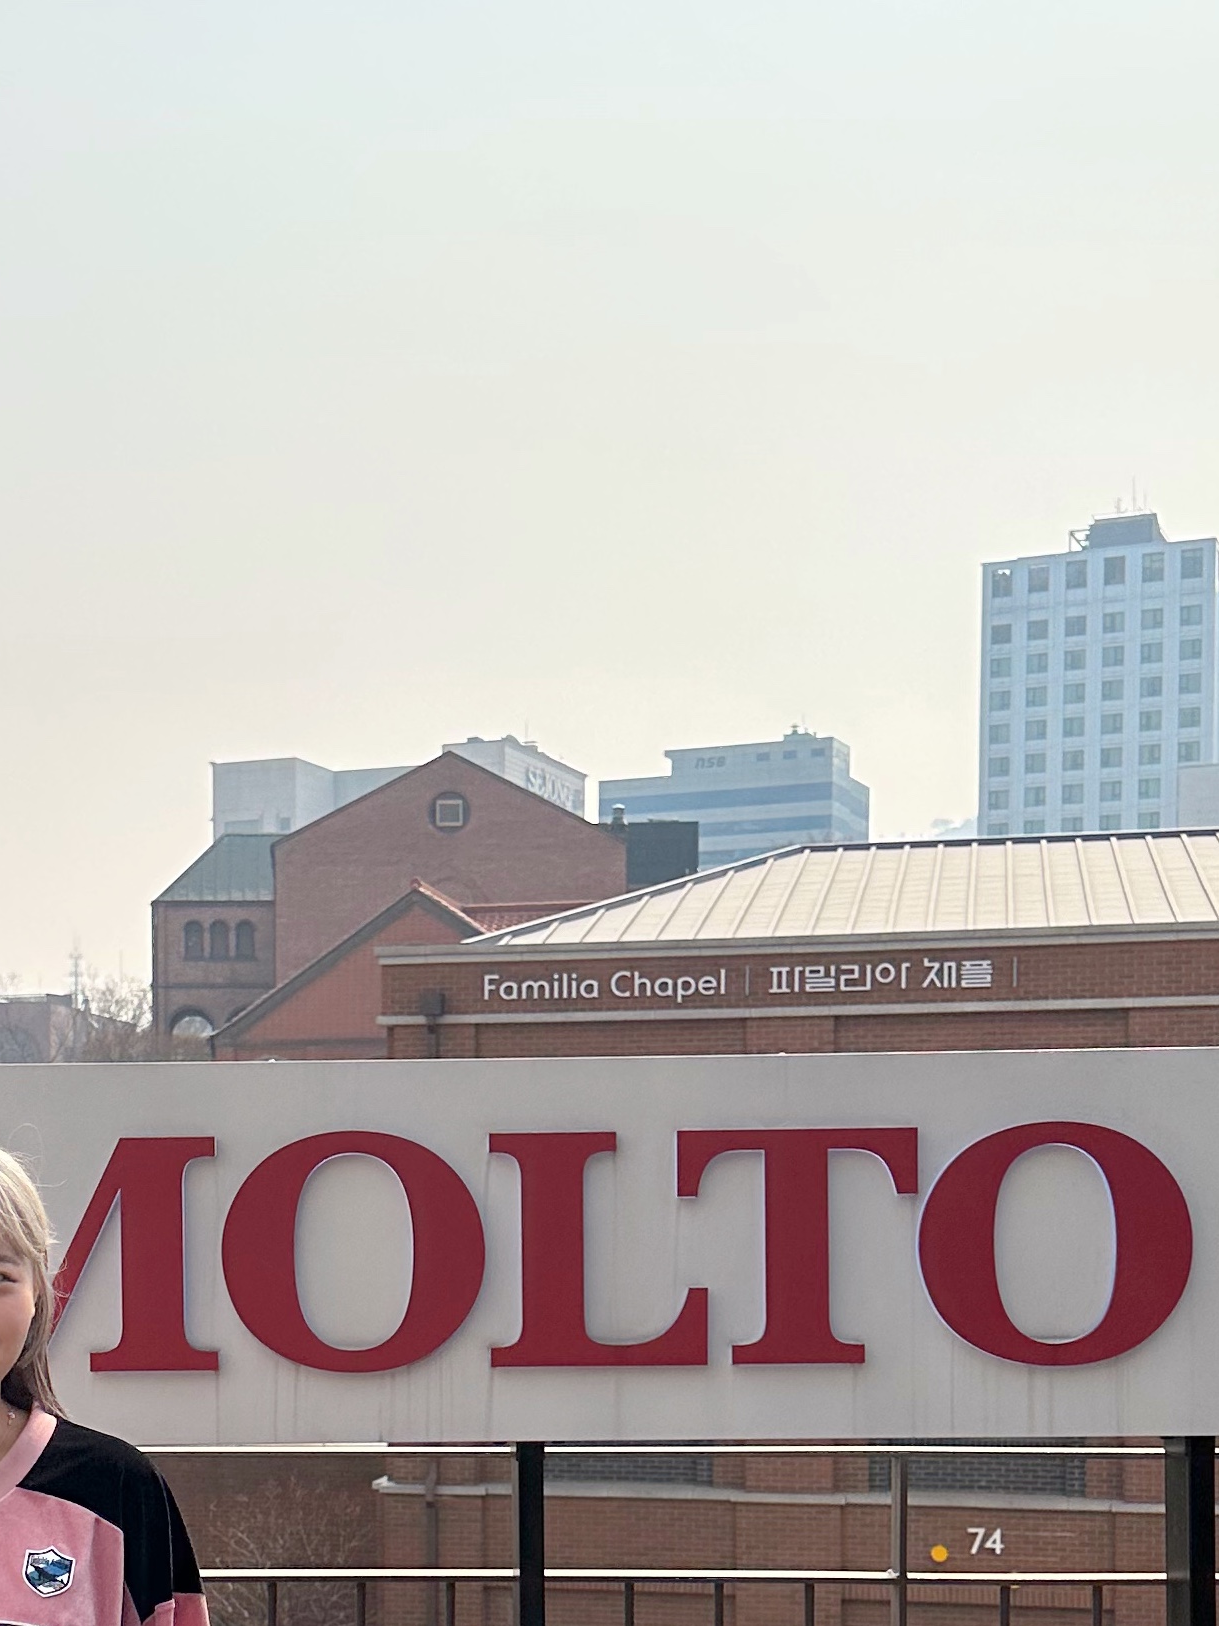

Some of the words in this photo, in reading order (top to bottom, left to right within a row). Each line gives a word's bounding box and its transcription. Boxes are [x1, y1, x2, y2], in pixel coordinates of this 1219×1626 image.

[483, 973, 600, 1000] Familia
[610, 968, 726, 1003] Chapel
[768, 962, 910, 994] 파밀리아
[921, 958, 994, 990] 채플
[966, 1527, 1006, 1556] 74
